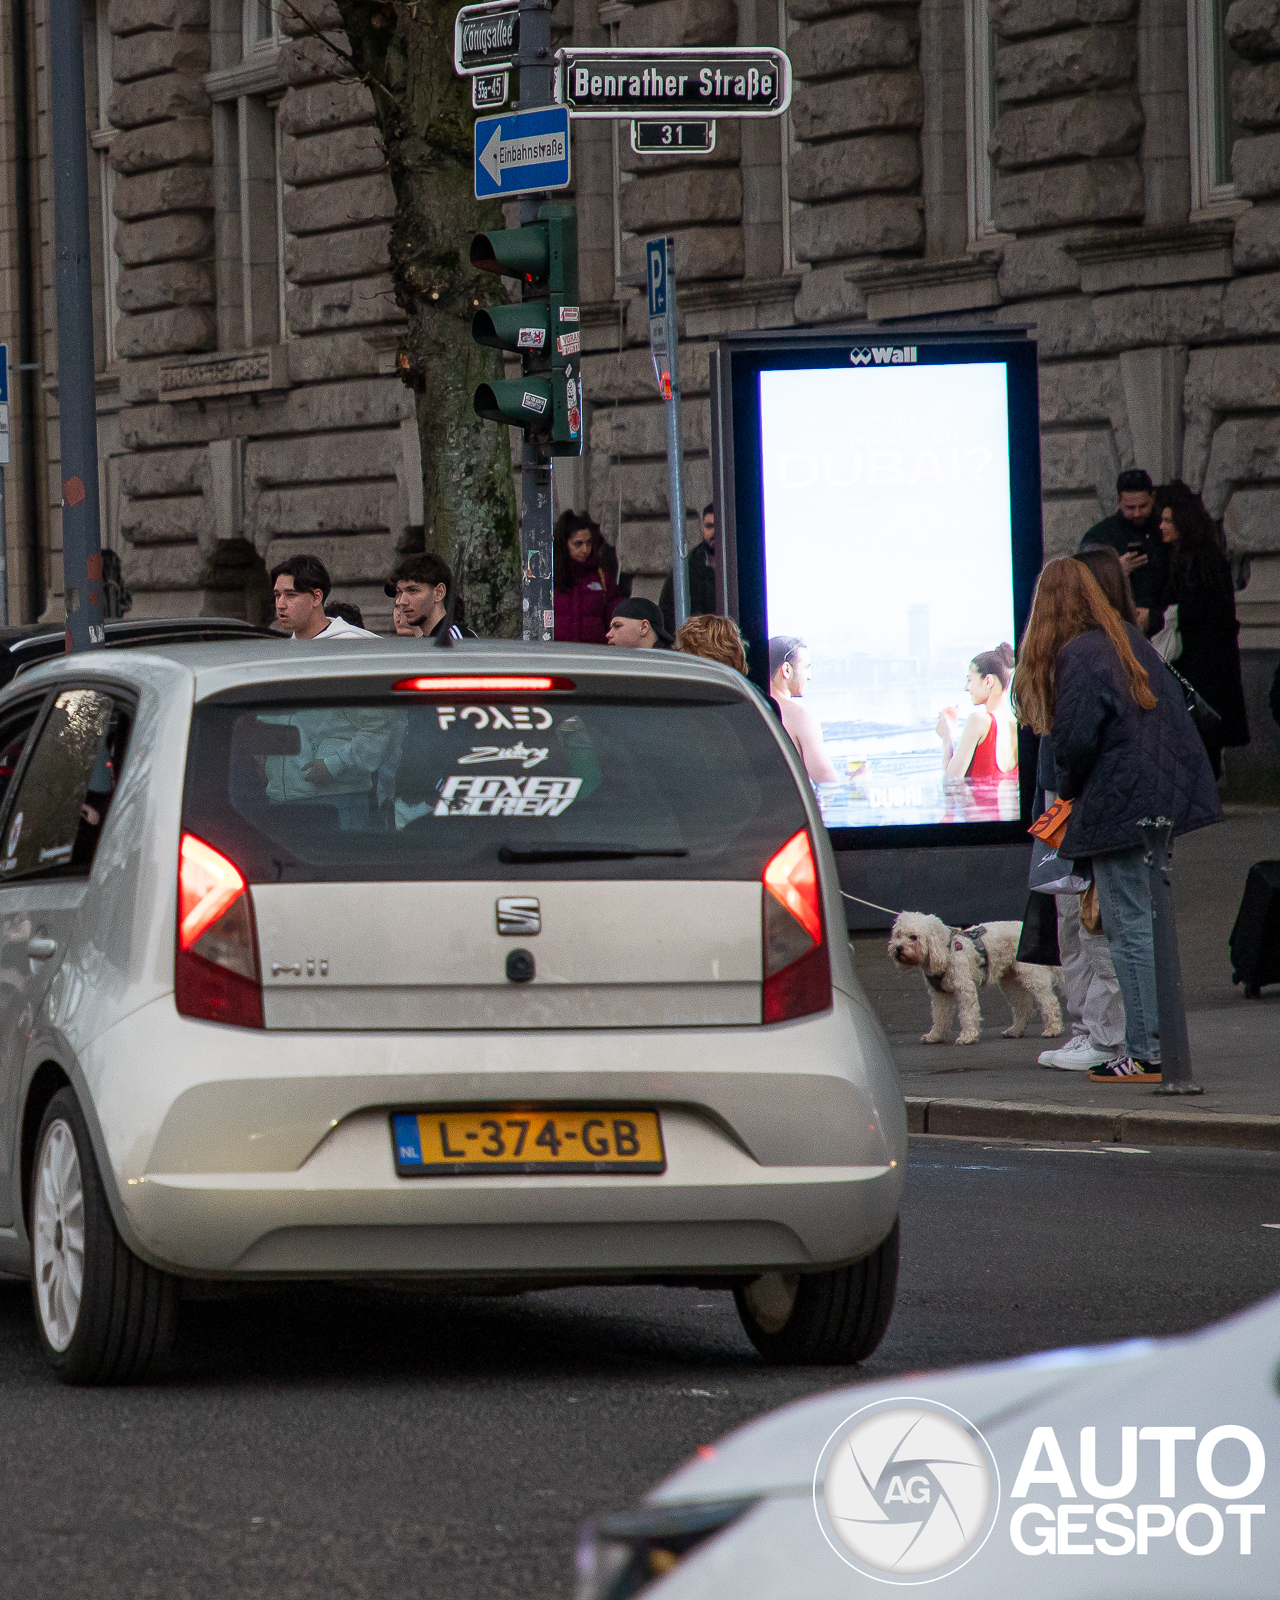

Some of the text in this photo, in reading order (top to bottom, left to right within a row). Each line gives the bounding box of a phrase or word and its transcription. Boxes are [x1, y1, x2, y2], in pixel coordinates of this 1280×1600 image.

[463, 20, 513, 54] Königsallee
[575, 67, 772, 101] Benrather Straße
[661, 125, 683, 145] 31
[499, 139, 563, 164] Einbahnstraße
[650, 249, 663, 313] P
[871, 347, 917, 363] Wall
[778, 446, 994, 489] DUBAI?
[441, 775, 584, 798] FOXED
[869, 786, 923, 809] DUBAI
[400, 1120, 641, 1158] NL L-374-GB
